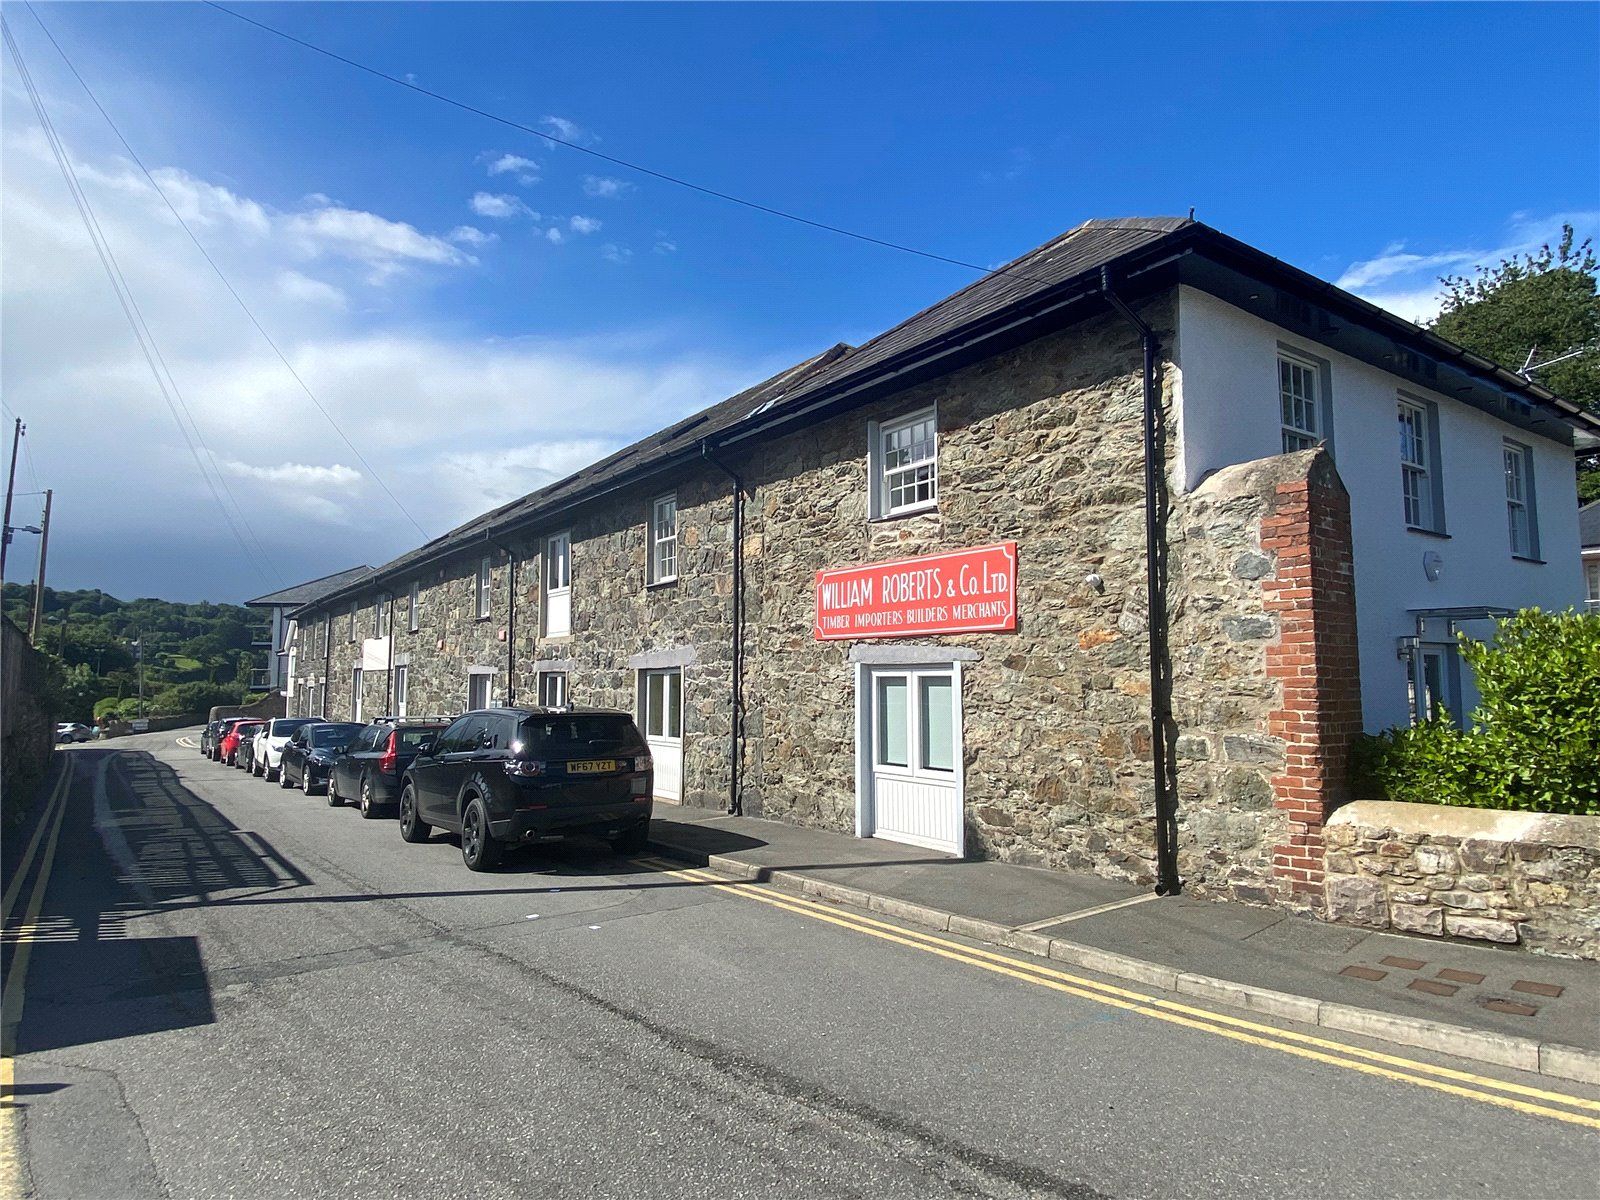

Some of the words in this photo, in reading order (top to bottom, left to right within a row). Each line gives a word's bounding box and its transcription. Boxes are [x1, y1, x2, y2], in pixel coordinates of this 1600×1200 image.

[822, 577, 873, 610] WILLIAM
[882, 567, 942, 604] ROBERTS
[946, 578, 956, 598] &
[822, 615, 851, 630] TIMBER
[854, 610, 904, 628] IMPORTERS
[906, 606, 948, 624] BUILDERS
[952, 600, 1007, 620] MERCHANTS
[570, 761, 594, 772] WF67
[595, 760, 612, 771] YZT
